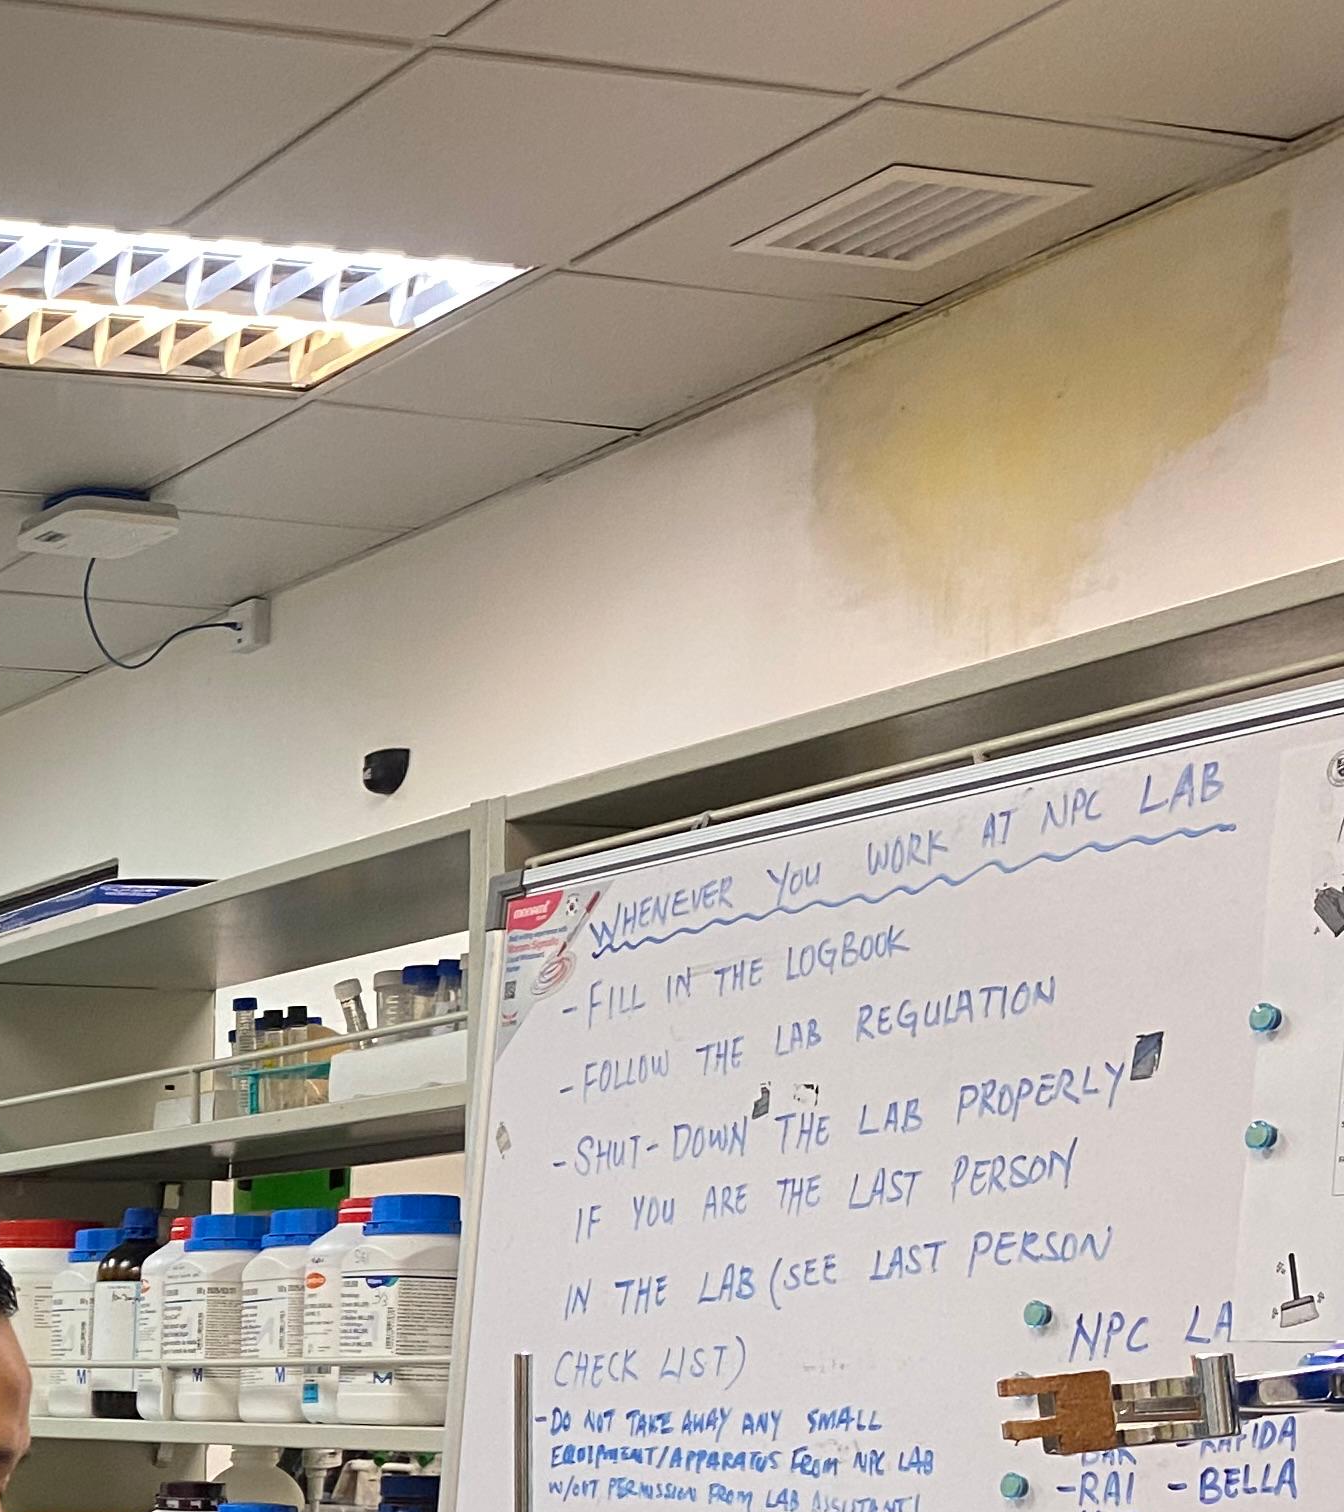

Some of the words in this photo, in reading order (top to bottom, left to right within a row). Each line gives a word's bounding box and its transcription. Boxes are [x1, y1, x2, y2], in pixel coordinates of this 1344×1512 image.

[589, 877, 734, 949] WHENEVER
[767, 862, 822, 911] YOU
[867, 831, 950, 882] WORK
[983, 811, 1017, 851] AT
[1040, 792, 1102, 838] NPC
[1140, 762, 1224, 815] LAB
[667, 967, 692, 1006] IN
[713, 959, 764, 999] THE
[786, 926, 910, 980] LOGBOOK
[696, 1035, 744, 1079] THE
[774, 1025, 822, 1060] LAB
[856, 977, 1057, 1041] REGULATION
[775, 1112, 830, 1152] THE
[858, 1098, 923, 1137] LAB
[958, 1061, 1126, 1127] PROPERLY
[576, 1207, 603, 1244] IF
[632, 1196, 674, 1233] YOU
[702, 1187, 748, 1221] ARE
[777, 1176, 821, 1214] THE
[849, 1170, 919, 1210] LAST
[952, 1138, 1079, 1198] PERSON
[565, 1284, 591, 1320] IN
[615, 1275, 669, 1315] THE
[869, 1241, 947, 1282] LAST
[968, 1226, 1113, 1280] PERSON
[554, 1348, 639, 1390] CHECK
[659, 1335, 747, 1391] LIST)
[1069, 1312, 1150, 1364] NPC
[584, 1409, 616, 1433] NOT
[742, 1409, 783, 1441] ANY
[807, 1406, 882, 1434] SMALL
[853, 1450, 885, 1476] NPC
[898, 1446, 935, 1476] LAB
[765, 1488, 800, 1512] LAB
